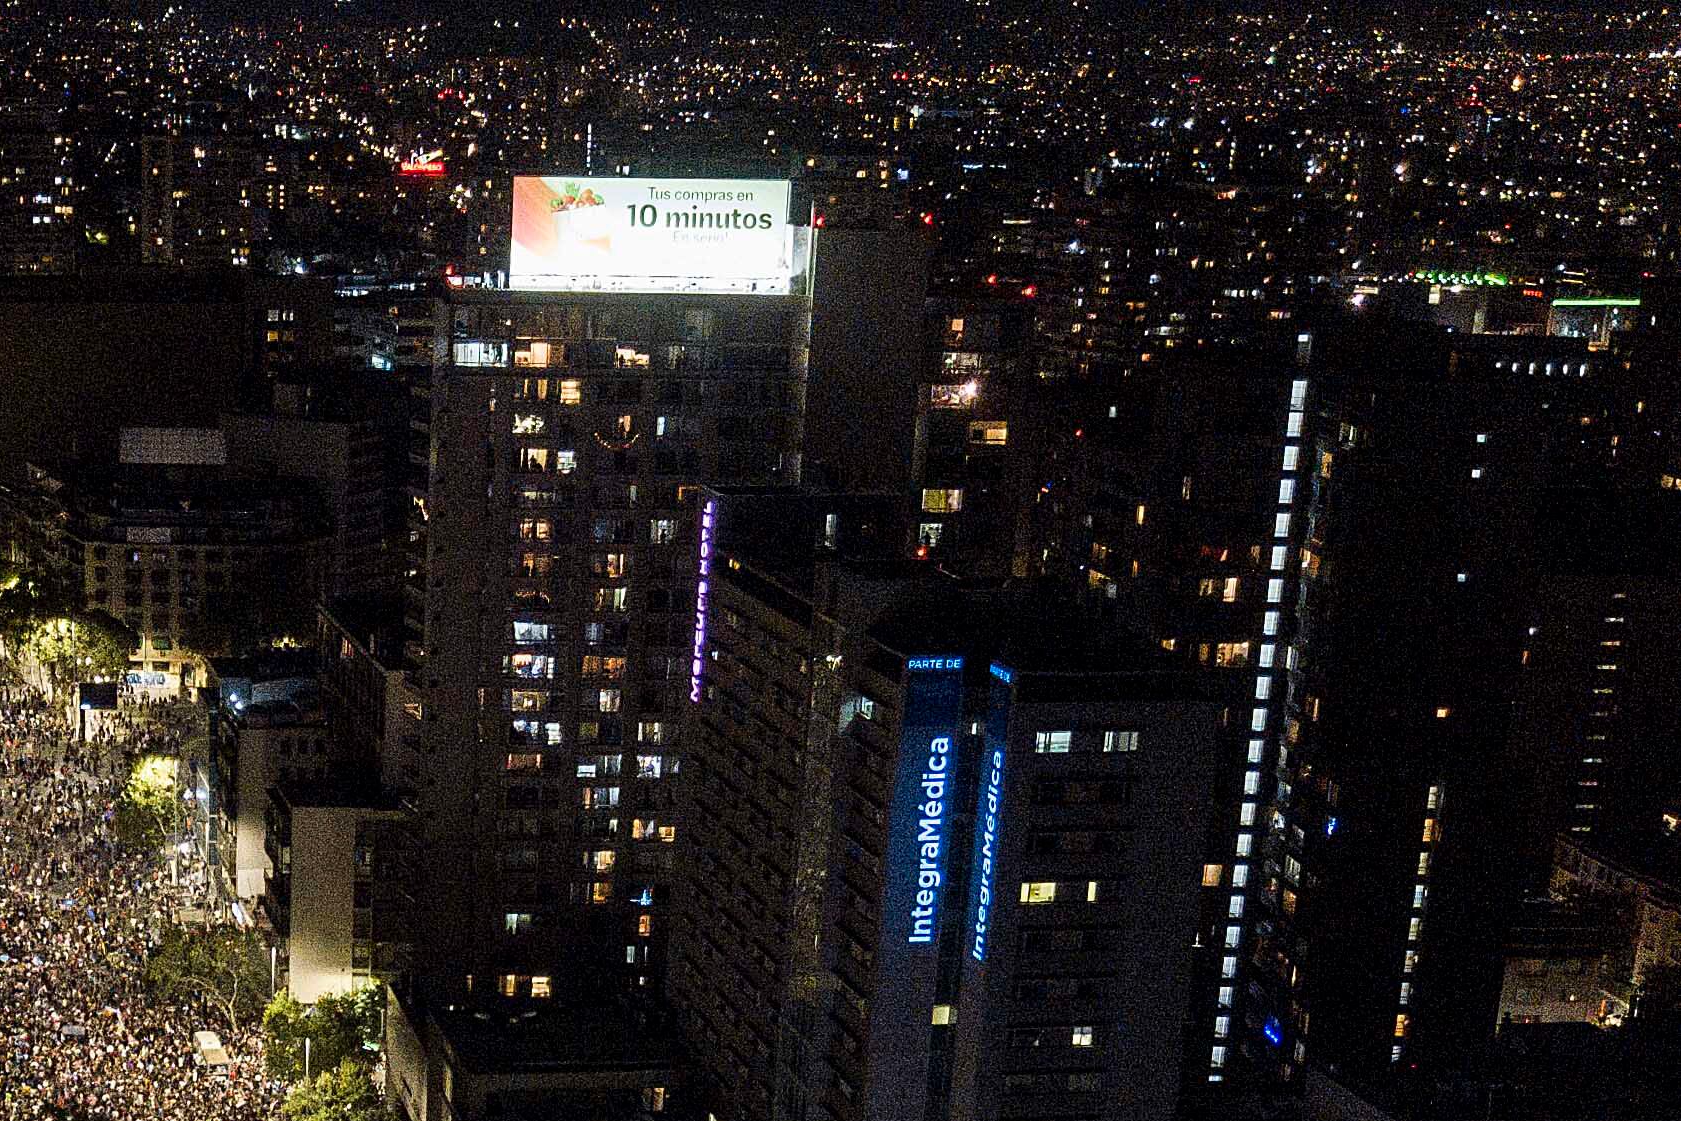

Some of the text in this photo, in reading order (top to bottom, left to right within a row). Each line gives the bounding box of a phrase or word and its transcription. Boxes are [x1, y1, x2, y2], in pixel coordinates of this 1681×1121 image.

[648, 186, 754, 204] Tus compras en
[627, 204, 773, 230] 10 minutos
[908, 659, 961, 669] PARTE DE
[908, 737, 949, 943] IntegraMédica
[972, 751, 1003, 961] IntegraMédica
